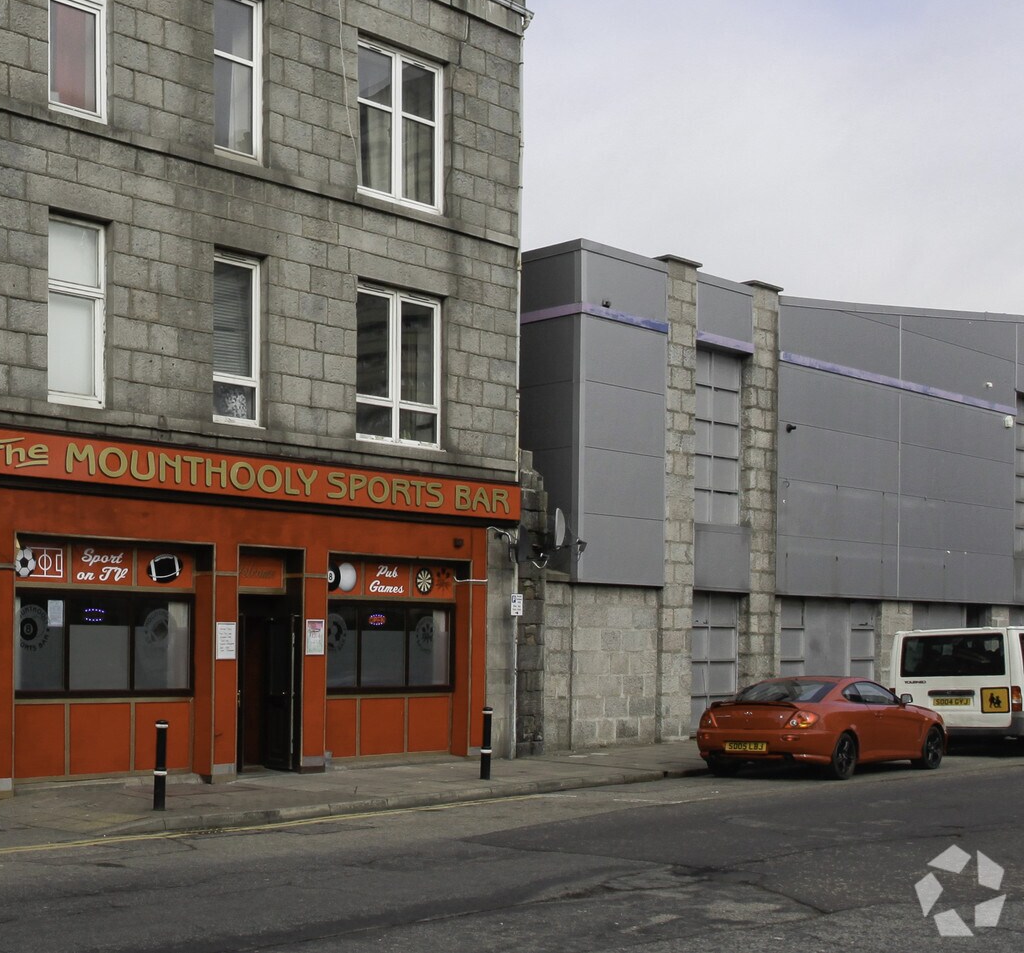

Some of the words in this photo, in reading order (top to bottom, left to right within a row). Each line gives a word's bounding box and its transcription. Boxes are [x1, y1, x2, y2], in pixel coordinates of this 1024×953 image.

[66, 442, 318, 496] MOUNTHOOLY
[327, 472, 444, 508] SPORTS
[455, 484, 510, 514] BAR
[81, 548, 124, 566] Sport
[77, 571, 95, 580] on
[99, 567, 128, 581] TV
[376, 565, 398, 577] Pub
[369, 579, 404, 594] Games
